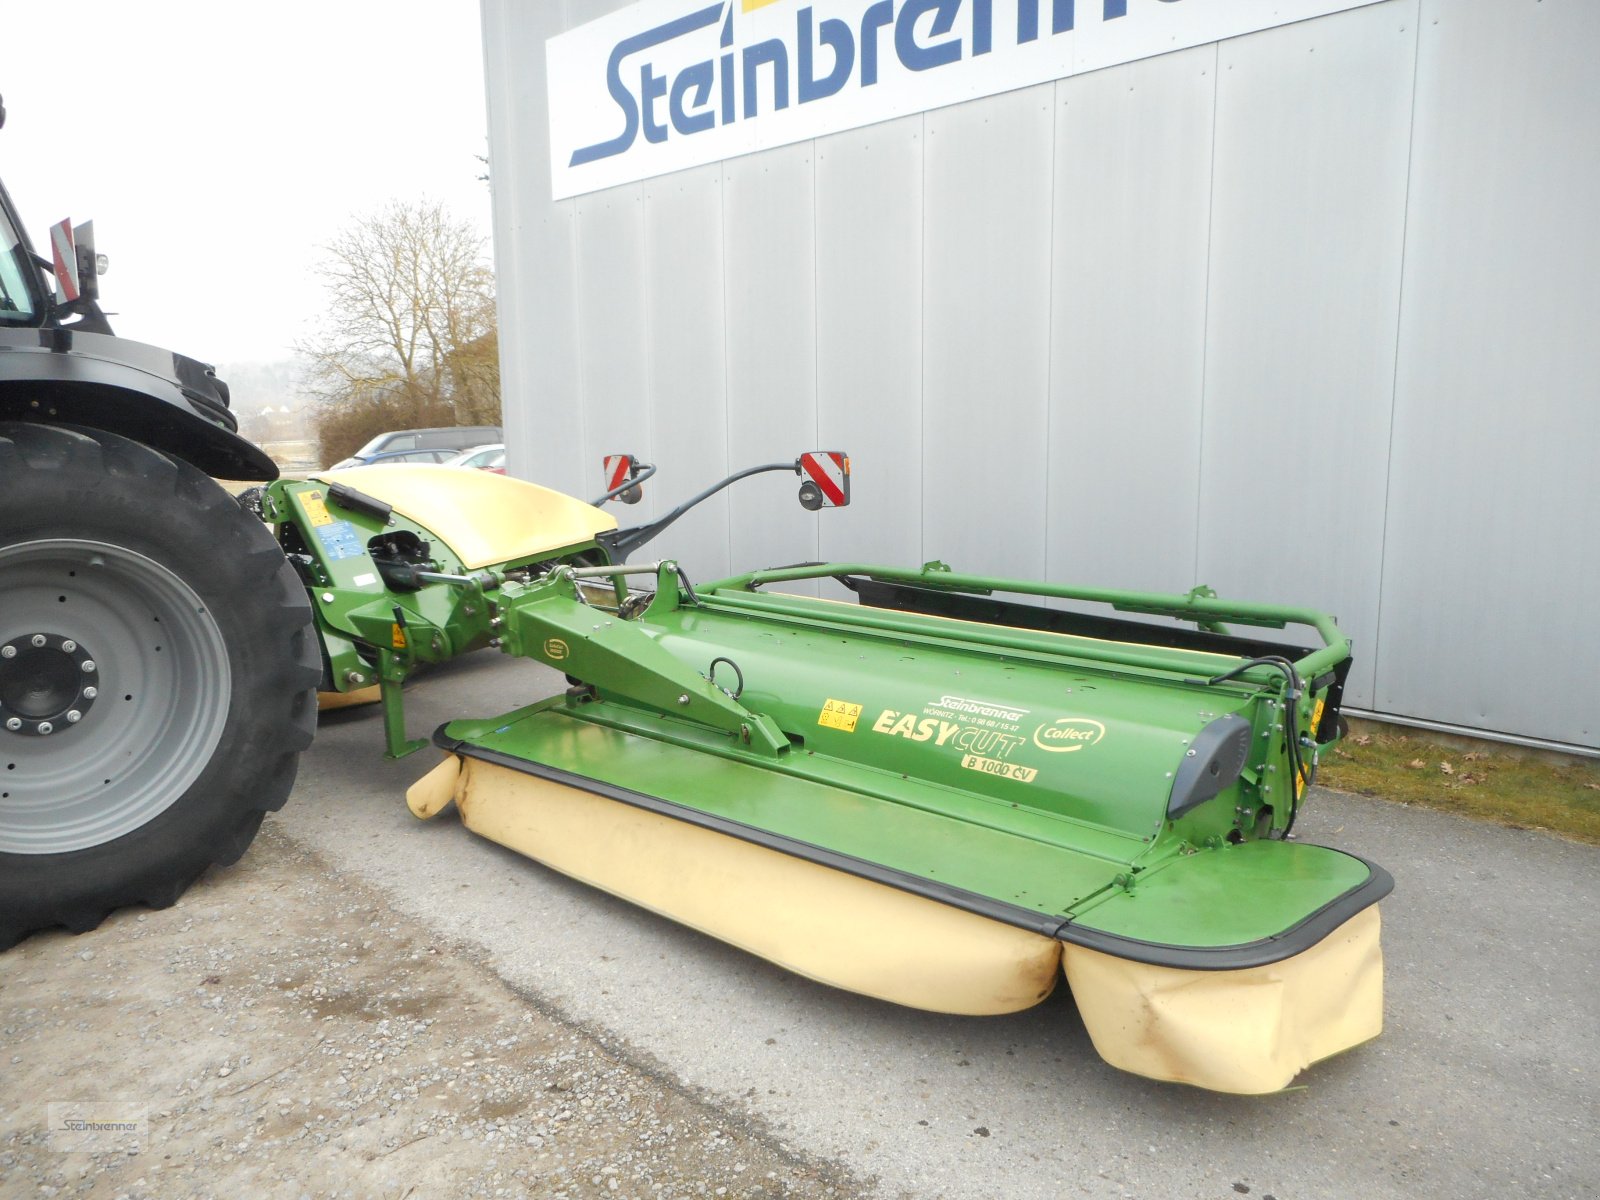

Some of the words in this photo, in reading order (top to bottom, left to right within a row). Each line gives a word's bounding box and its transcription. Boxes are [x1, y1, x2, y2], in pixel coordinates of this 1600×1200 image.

[928, 695, 1030, 721] Steinbrenner
[1044, 727, 1094, 740] Collect
[967, 757, 976, 768] B
[981, 760, 1010, 775] 1000
[1012, 767, 1031, 780] CV
